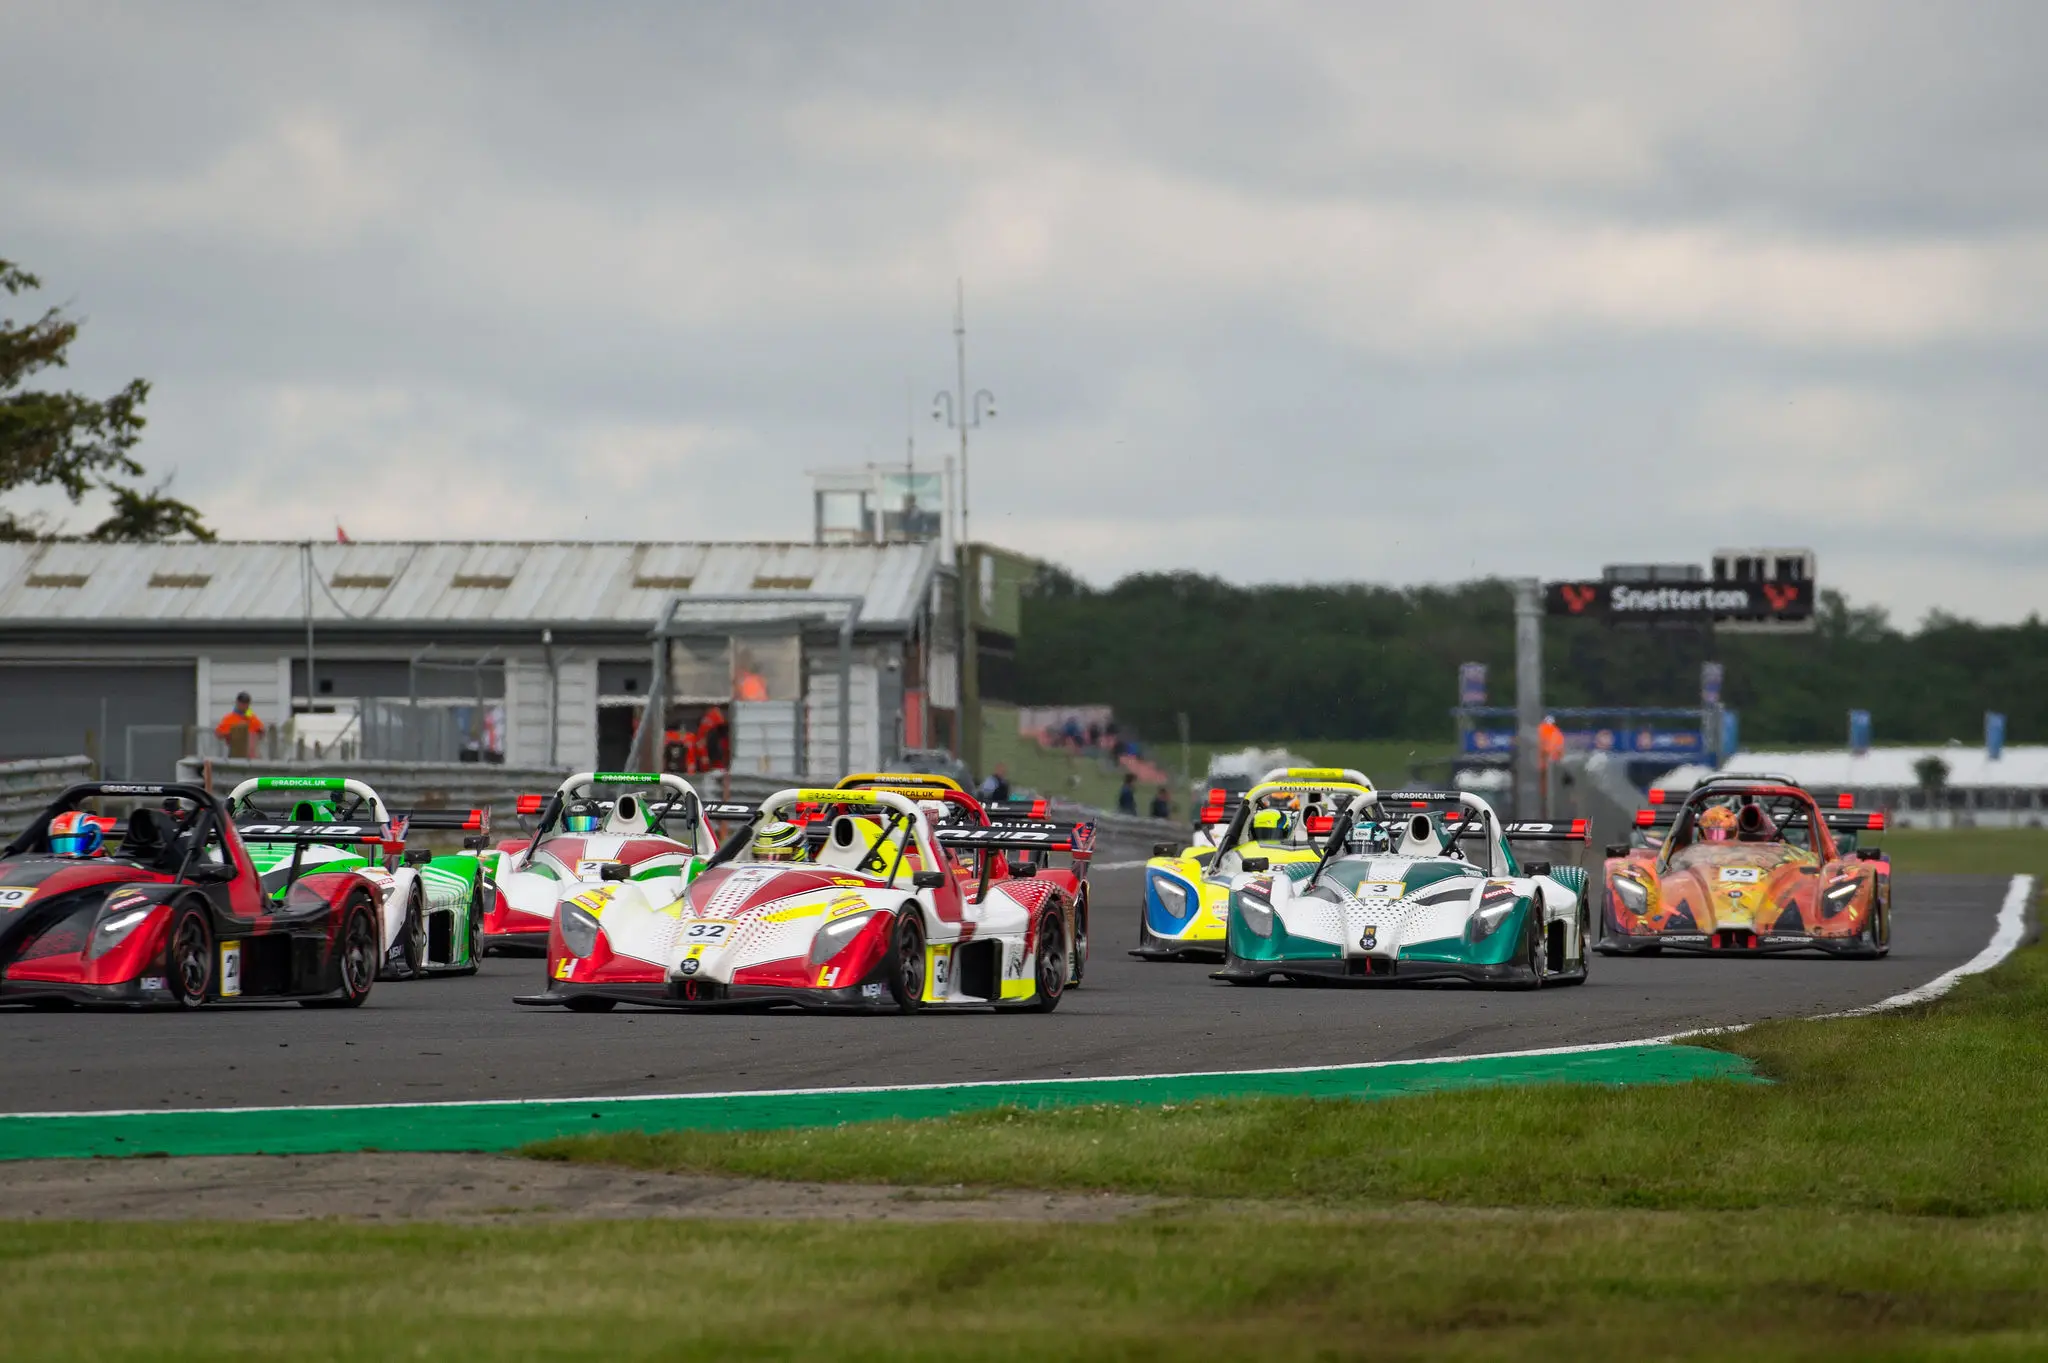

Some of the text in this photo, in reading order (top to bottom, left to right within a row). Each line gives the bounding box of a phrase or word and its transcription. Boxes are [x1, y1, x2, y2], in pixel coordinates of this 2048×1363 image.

[1610, 584, 1749, 610] Snetterton
[271, 779, 327, 787] @RADICAL.UK
[1391, 792, 1446, 800] @RADICAL.UK
[1726, 869, 1753, 877] 95
[1373, 884, 1388, 892] 3
[0, 891, 23, 900] 0
[1484, 888, 1512, 899] MOTUL
[688, 924, 726, 937] 32
